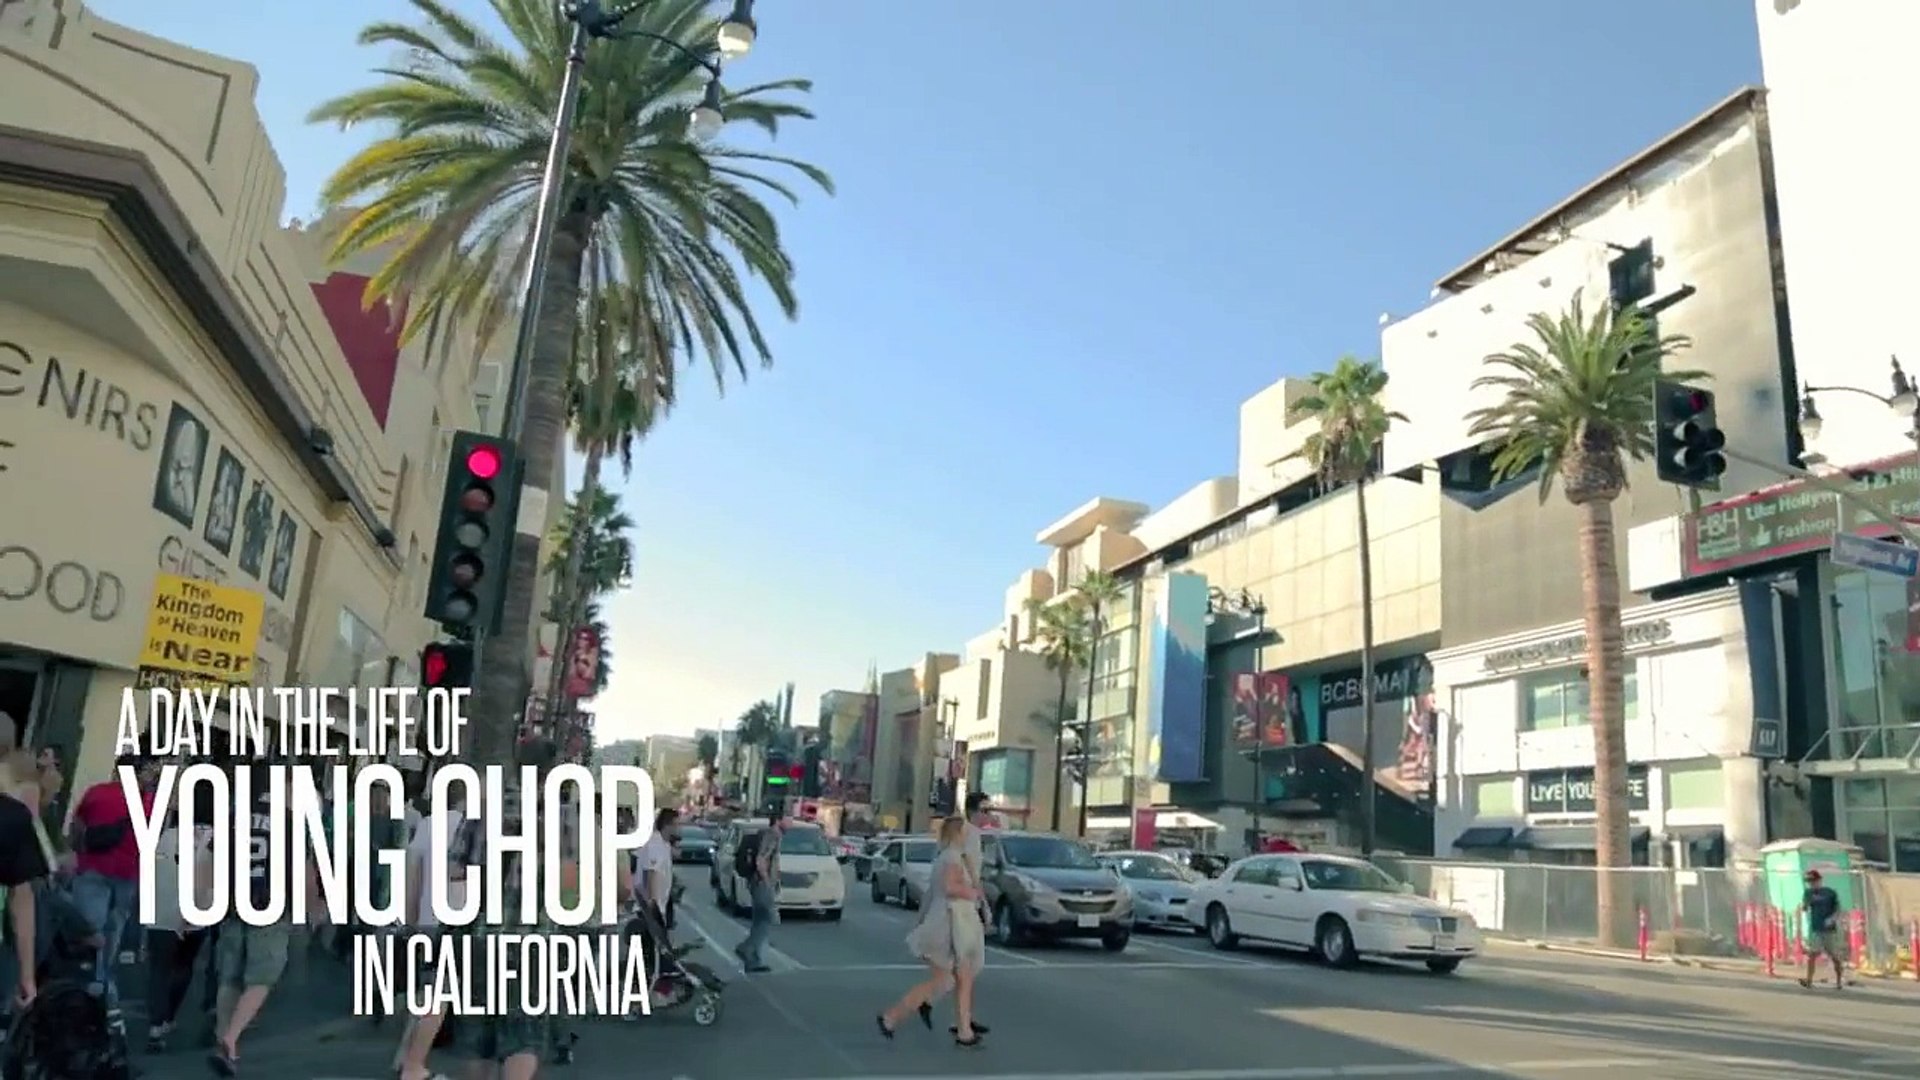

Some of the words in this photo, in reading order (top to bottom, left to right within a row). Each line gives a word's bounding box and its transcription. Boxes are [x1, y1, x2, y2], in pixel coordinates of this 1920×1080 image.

[181, 582, 212, 599] The
[156, 594, 244, 624] Kingdom
[172, 618, 241, 644] Heaven
[150, 638, 162, 652] is
[163, 640, 250, 672] Near
[1530, 783, 1563, 802] LIVE
[1568, 781, 1597, 800] YOU
